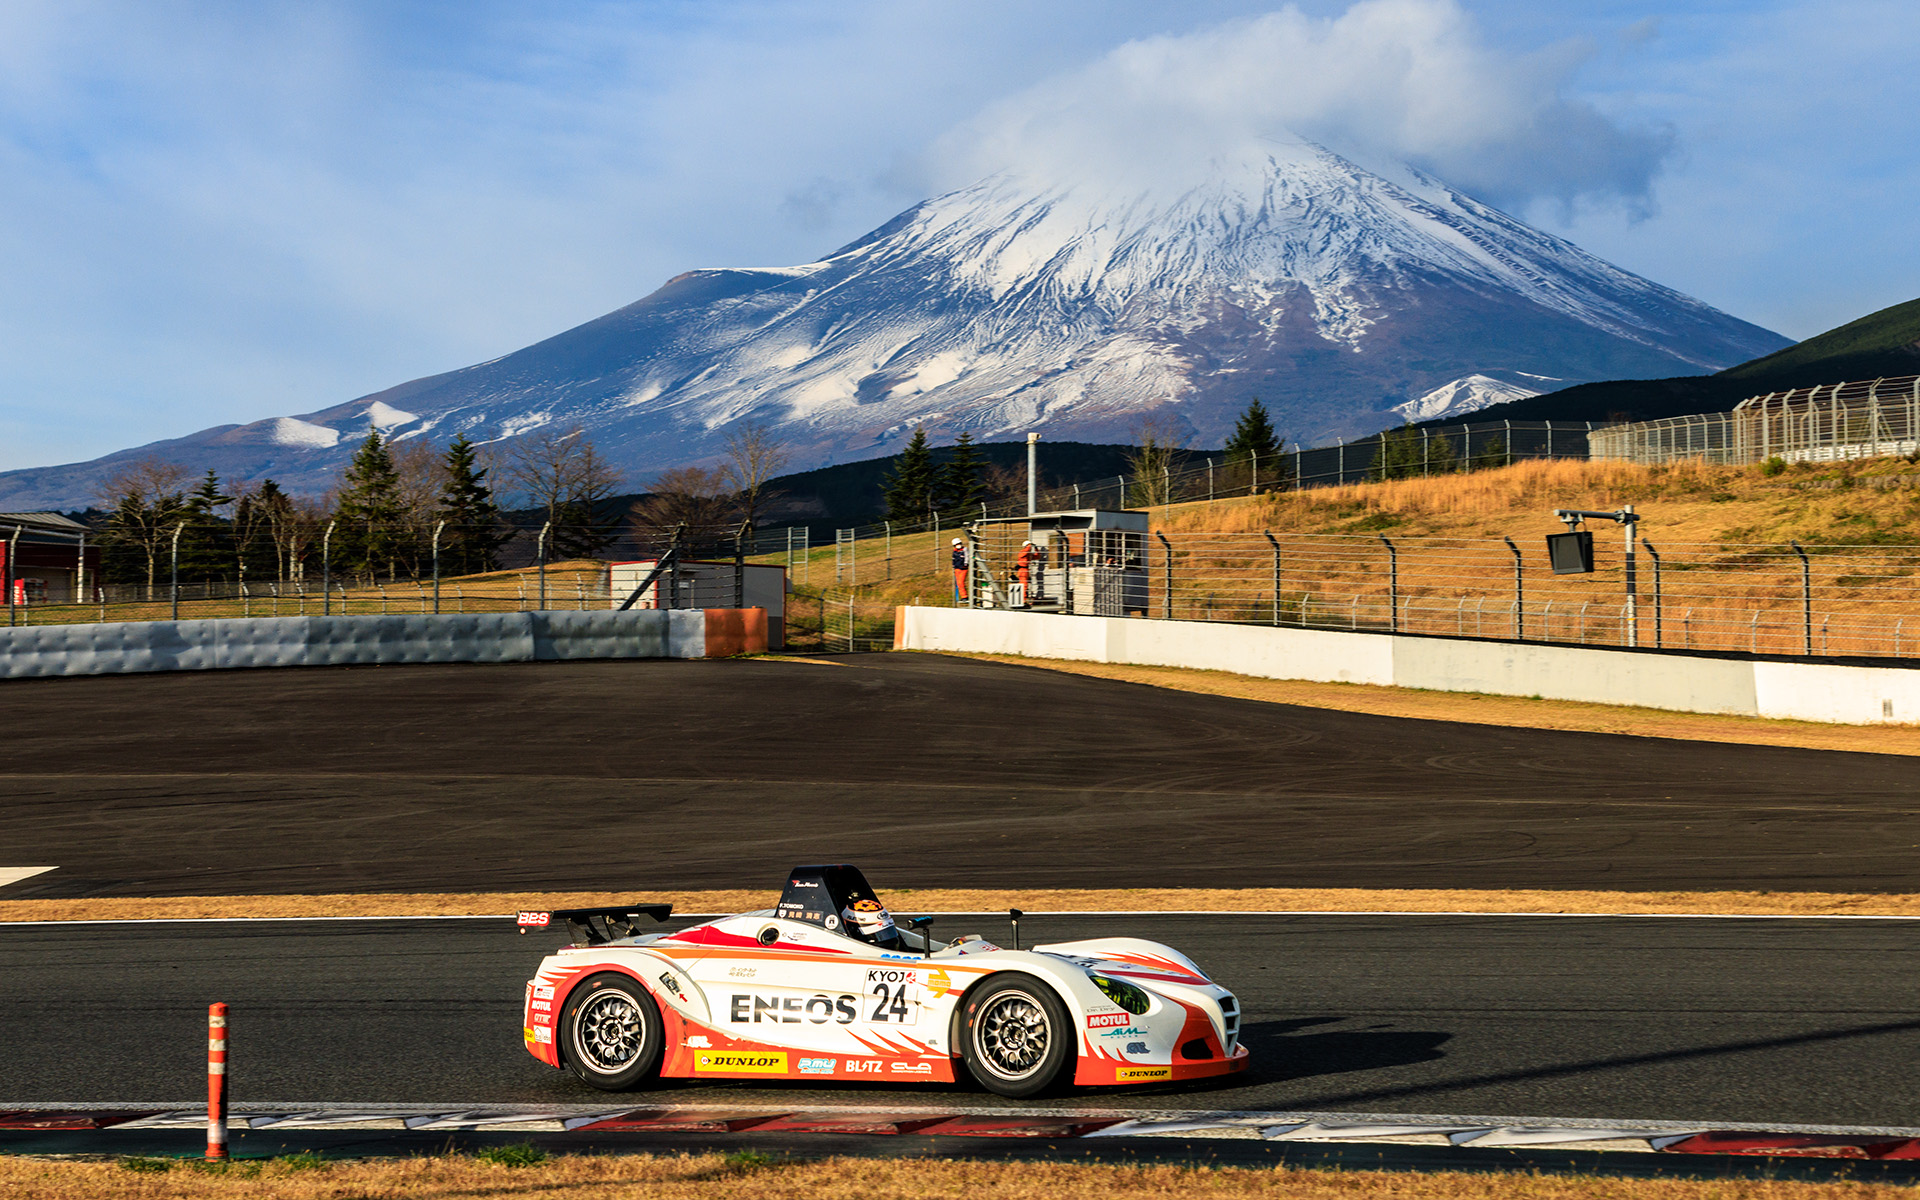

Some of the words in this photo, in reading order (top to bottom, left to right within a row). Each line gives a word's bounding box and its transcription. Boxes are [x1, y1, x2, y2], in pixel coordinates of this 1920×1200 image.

[1010, 585, 1022, 607] 11
[518, 912, 549, 925] BBS
[532, 1000, 552, 1011] MOTUL
[731, 994, 857, 1024] ENEOS
[871, 983, 908, 1023] 24
[1089, 1015, 1128, 1027] MOTUL
[713, 1057, 779, 1066] DUNLOP
